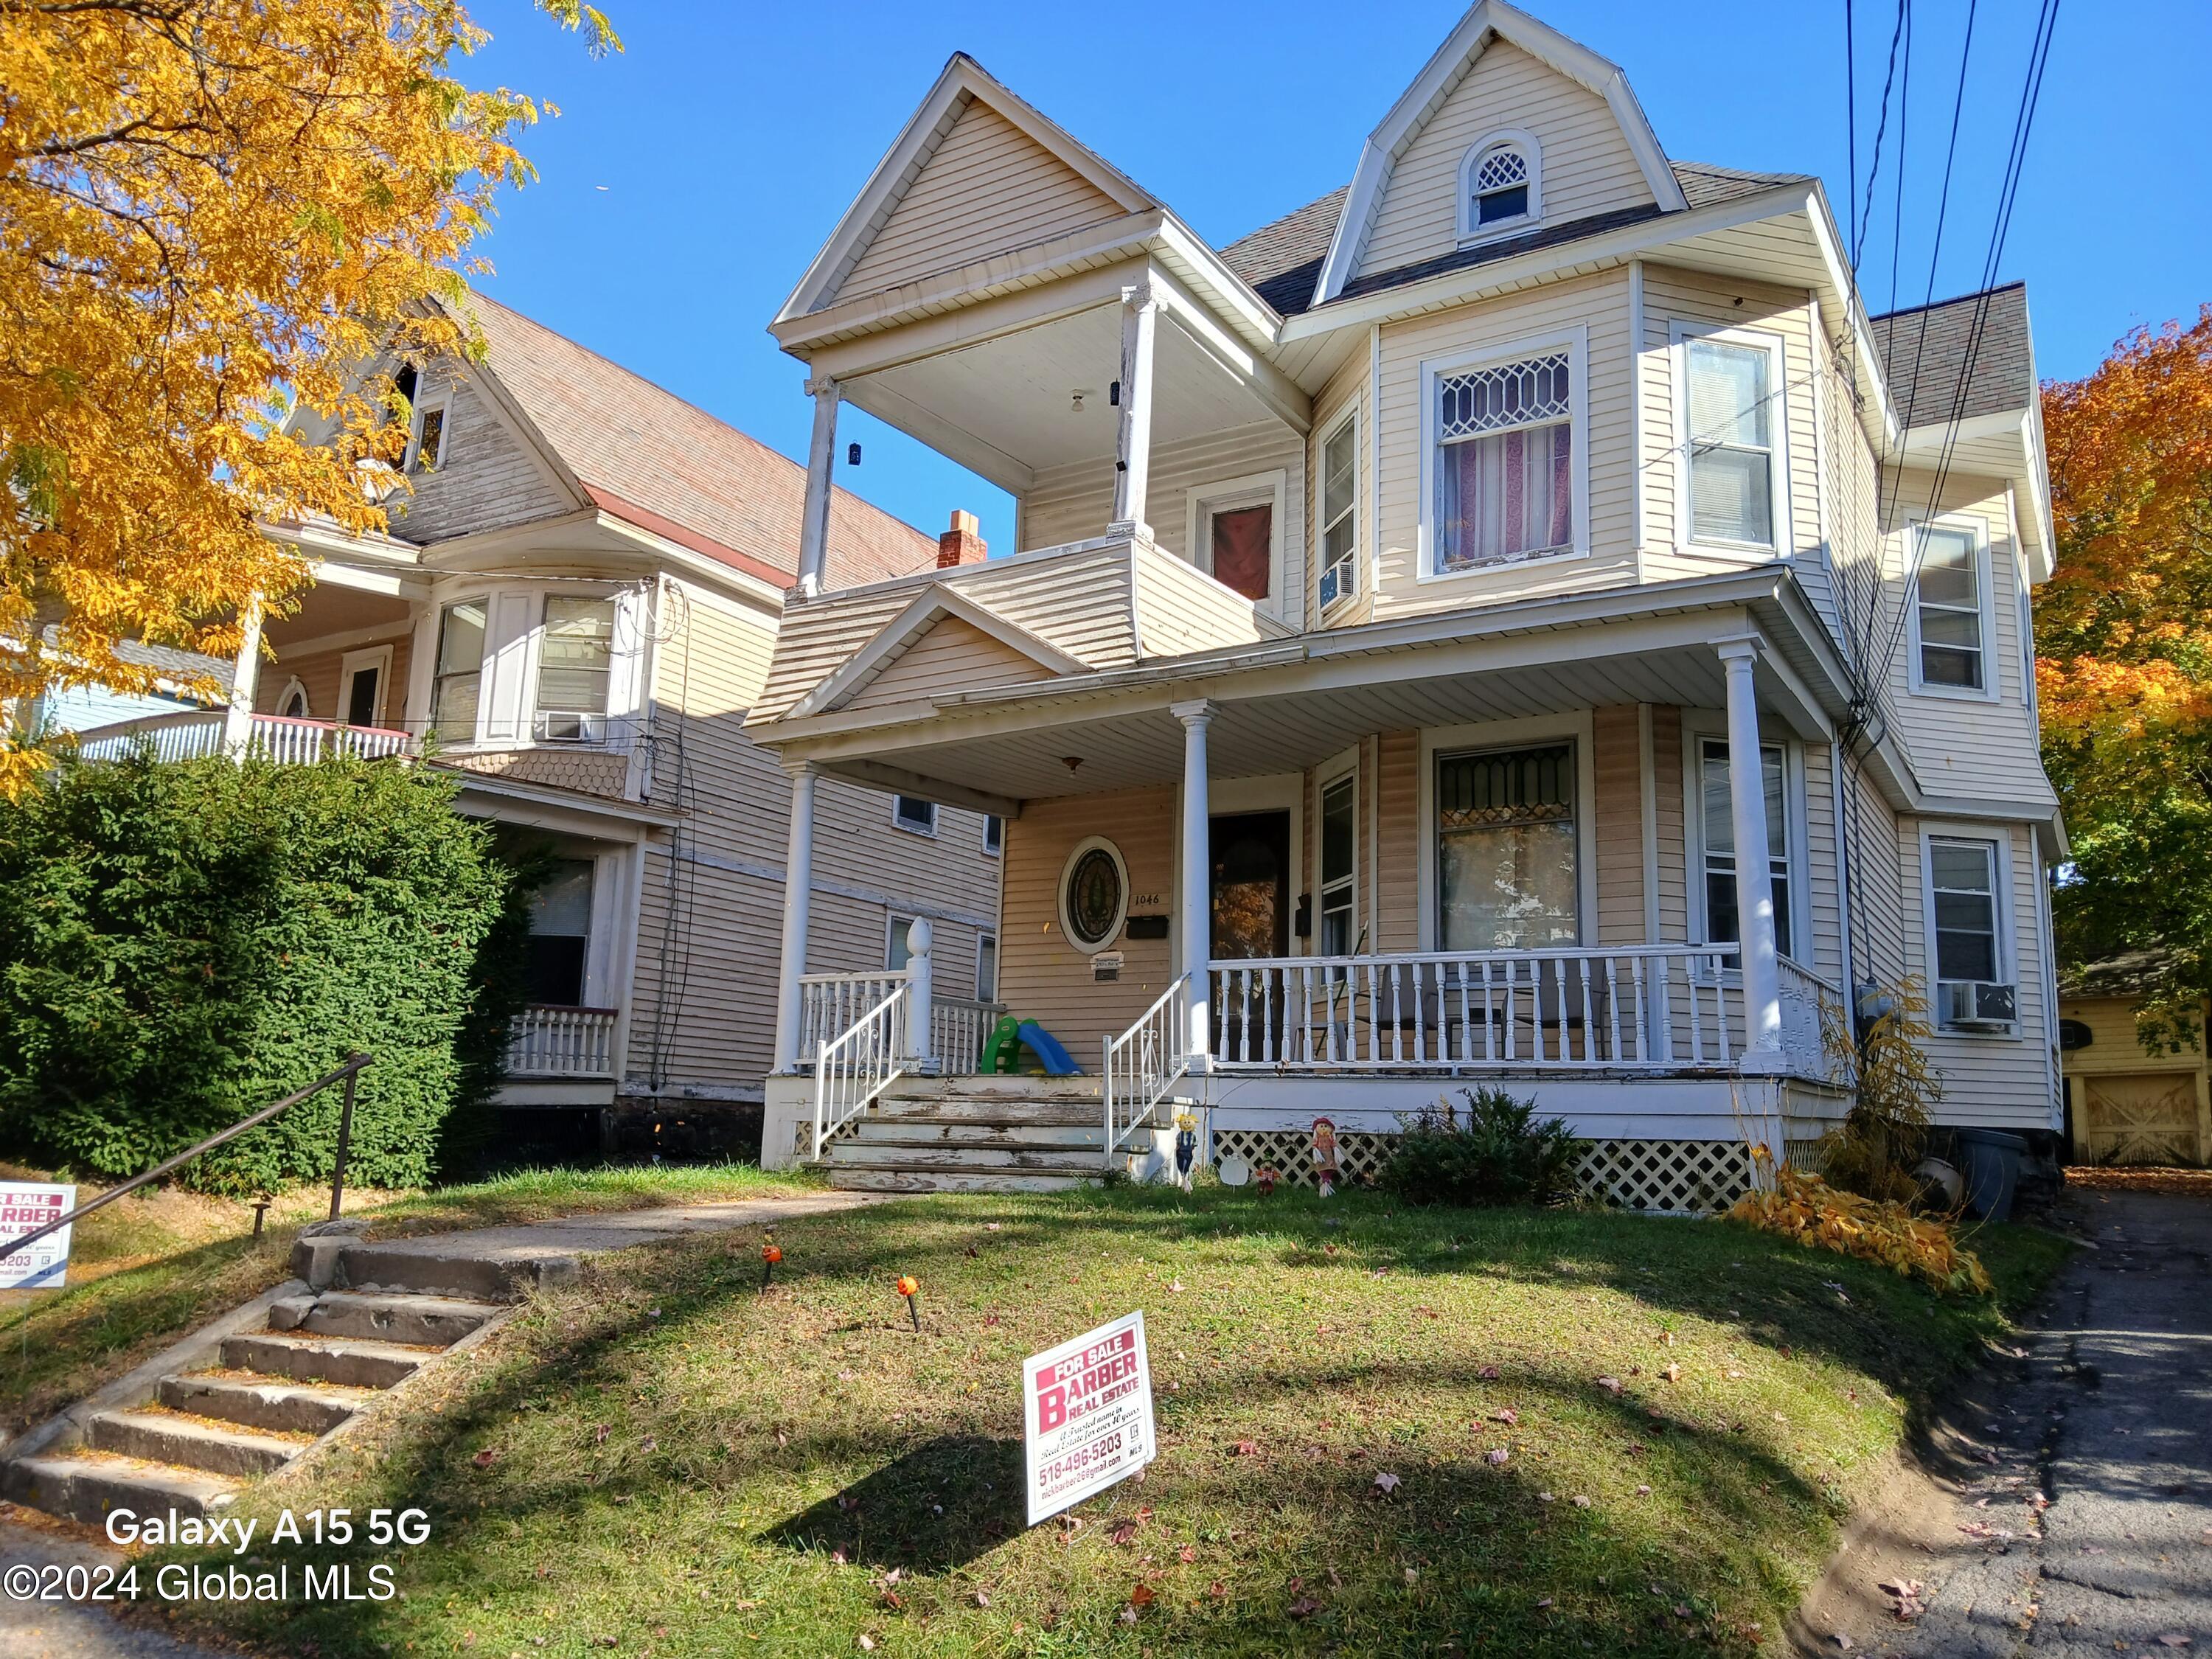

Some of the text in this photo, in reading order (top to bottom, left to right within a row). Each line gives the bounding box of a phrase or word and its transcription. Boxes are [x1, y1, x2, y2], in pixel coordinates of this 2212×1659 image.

[1135, 894, 1159, 905] 1046
[1, 1208, 60, 1222] RBER
[11, 1194, 50, 1206] SALE
[0, 1225, 14, 1234] AL
[1054, 1335, 1123, 1382] FOR SALE
[1038, 1351, 1138, 1436] BARBER
[1068, 1377, 1140, 1421] REAL ESTATE
[1096, 1411, 1115, 1423] name
[1116, 1405, 1122, 1414] in
[1040, 1443, 1060, 1460] Real
[1084, 1428, 1095, 1441] for
[1096, 1422, 1111, 1433] over
[1121, 1408, 1140, 1422] years
[1040, 1432, 1121, 1486] 518-496-5203
[1041, 1455, 1121, 1500] nickbarber26@gmail.com
